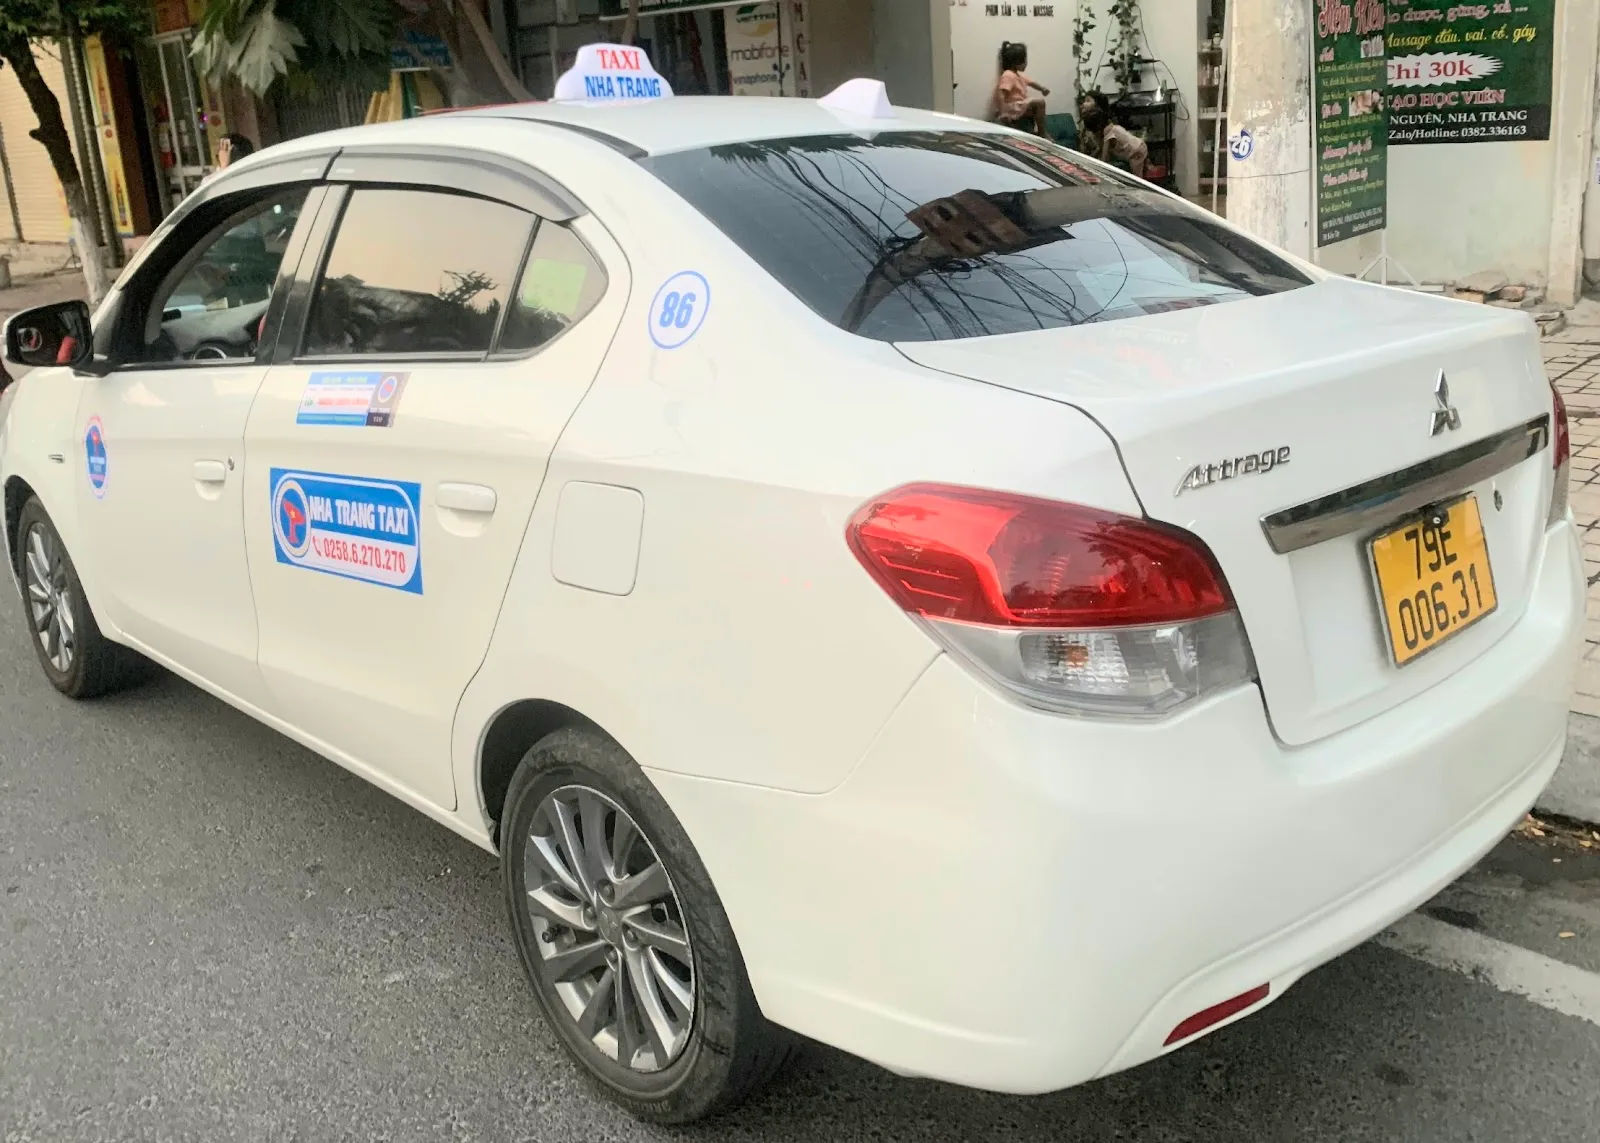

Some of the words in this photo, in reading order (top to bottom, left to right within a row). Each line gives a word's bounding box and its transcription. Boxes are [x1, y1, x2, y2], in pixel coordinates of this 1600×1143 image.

[596, 48, 641, 71] TAXI
[1428, 59, 1474, 78] 30k
[585, 76, 616, 98] NHA
[616, 76, 662, 98] TRANG
[1419, 92, 1459, 110] HỌC
[1461, 86, 1506, 105] VIÊN
[1447, 112, 1477, 124] NHA
[1480, 110, 1528, 121] TRANG
[1388, 128, 1459, 141] Zalo/Hotline:
[1461, 125, 1527, 138] 0382.336163
[659, 291, 697, 329] 86
[1174, 445, 1291, 497] Attrage
[309, 496, 333, 523] NHA
[335, 499, 376, 531] TRANG
[377, 505, 409, 536] TAXI
[323, 537, 406, 574] 0258.6.270.270
[1404, 521, 1458, 581] 79E
[1398, 562, 1483, 651] 006.31
